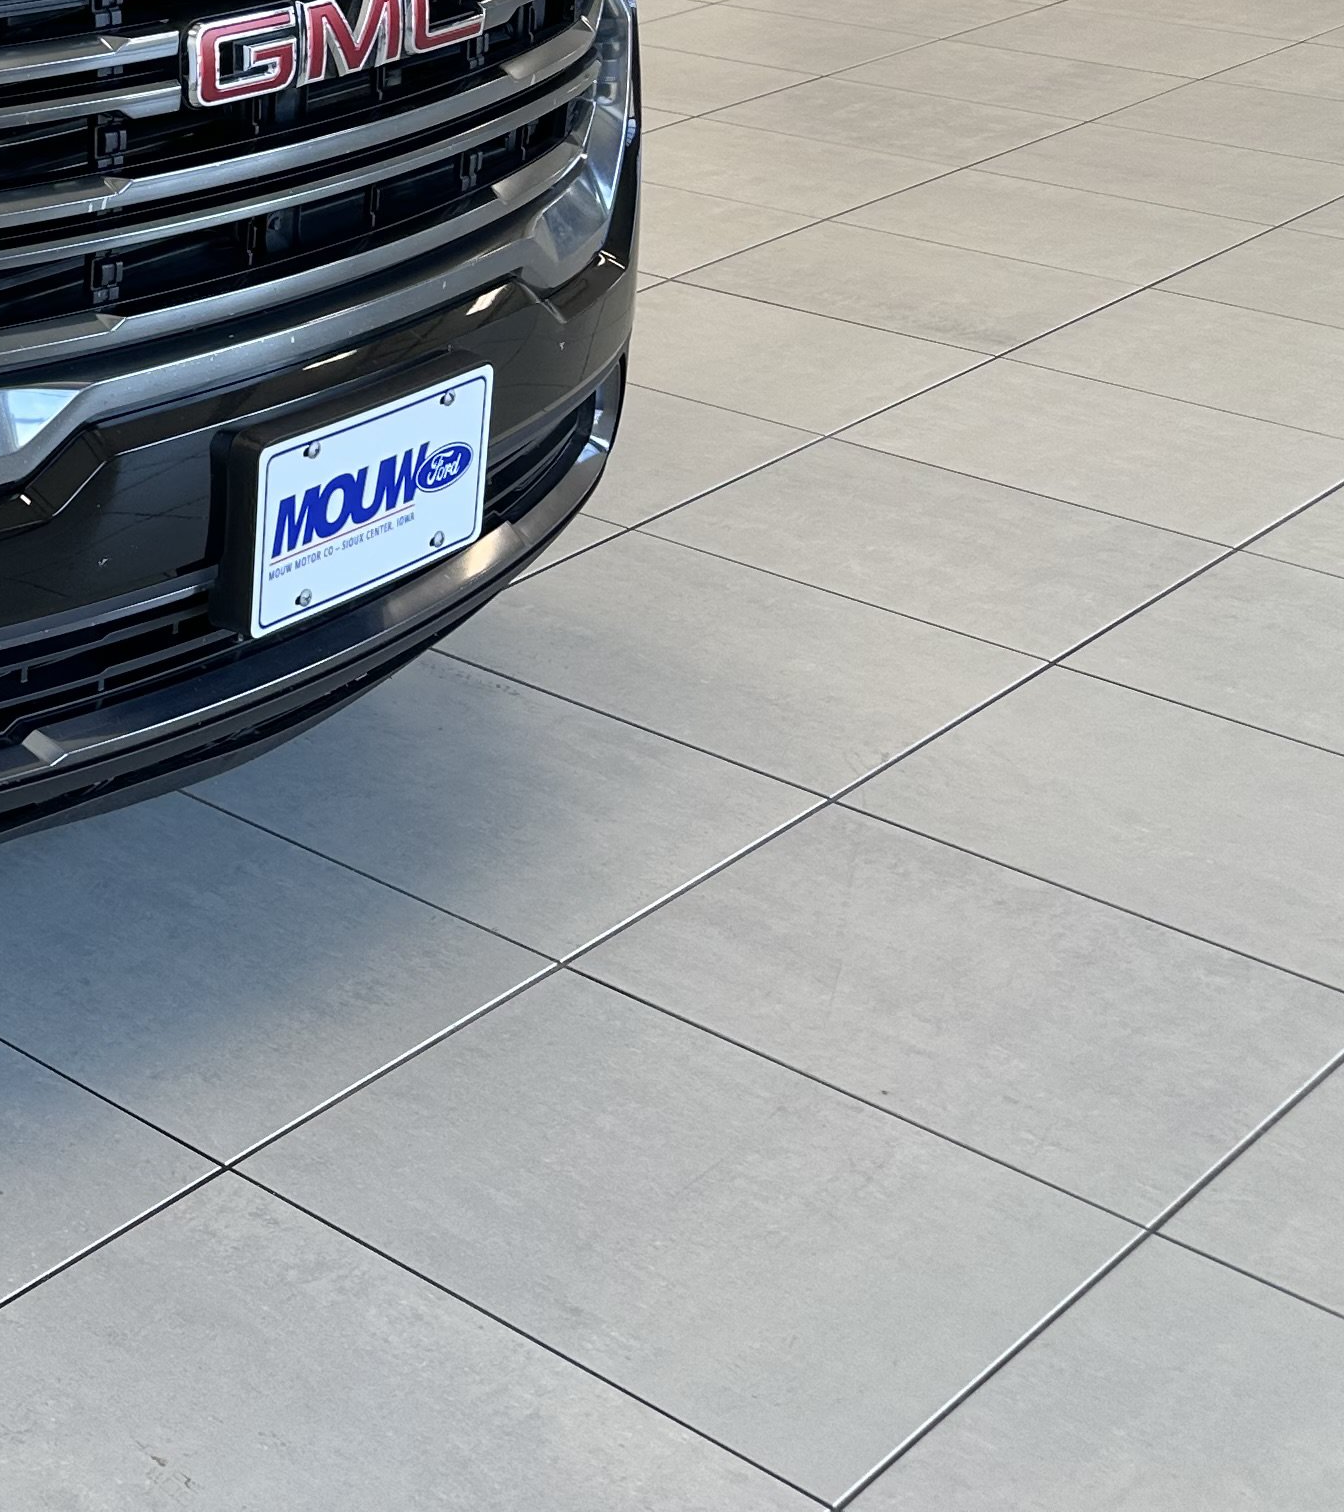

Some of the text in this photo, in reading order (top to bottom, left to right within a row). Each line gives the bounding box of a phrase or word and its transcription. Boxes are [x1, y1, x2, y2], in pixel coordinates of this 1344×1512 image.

[268, 563, 293, 581] MOUW
[295, 550, 322, 570] MOTOR
[323, 545, 334, 558] CO
[342, 532, 364, 550] SIOUX
[396, 511, 415, 528] IOWA
[271, 441, 430, 559] MOUW
